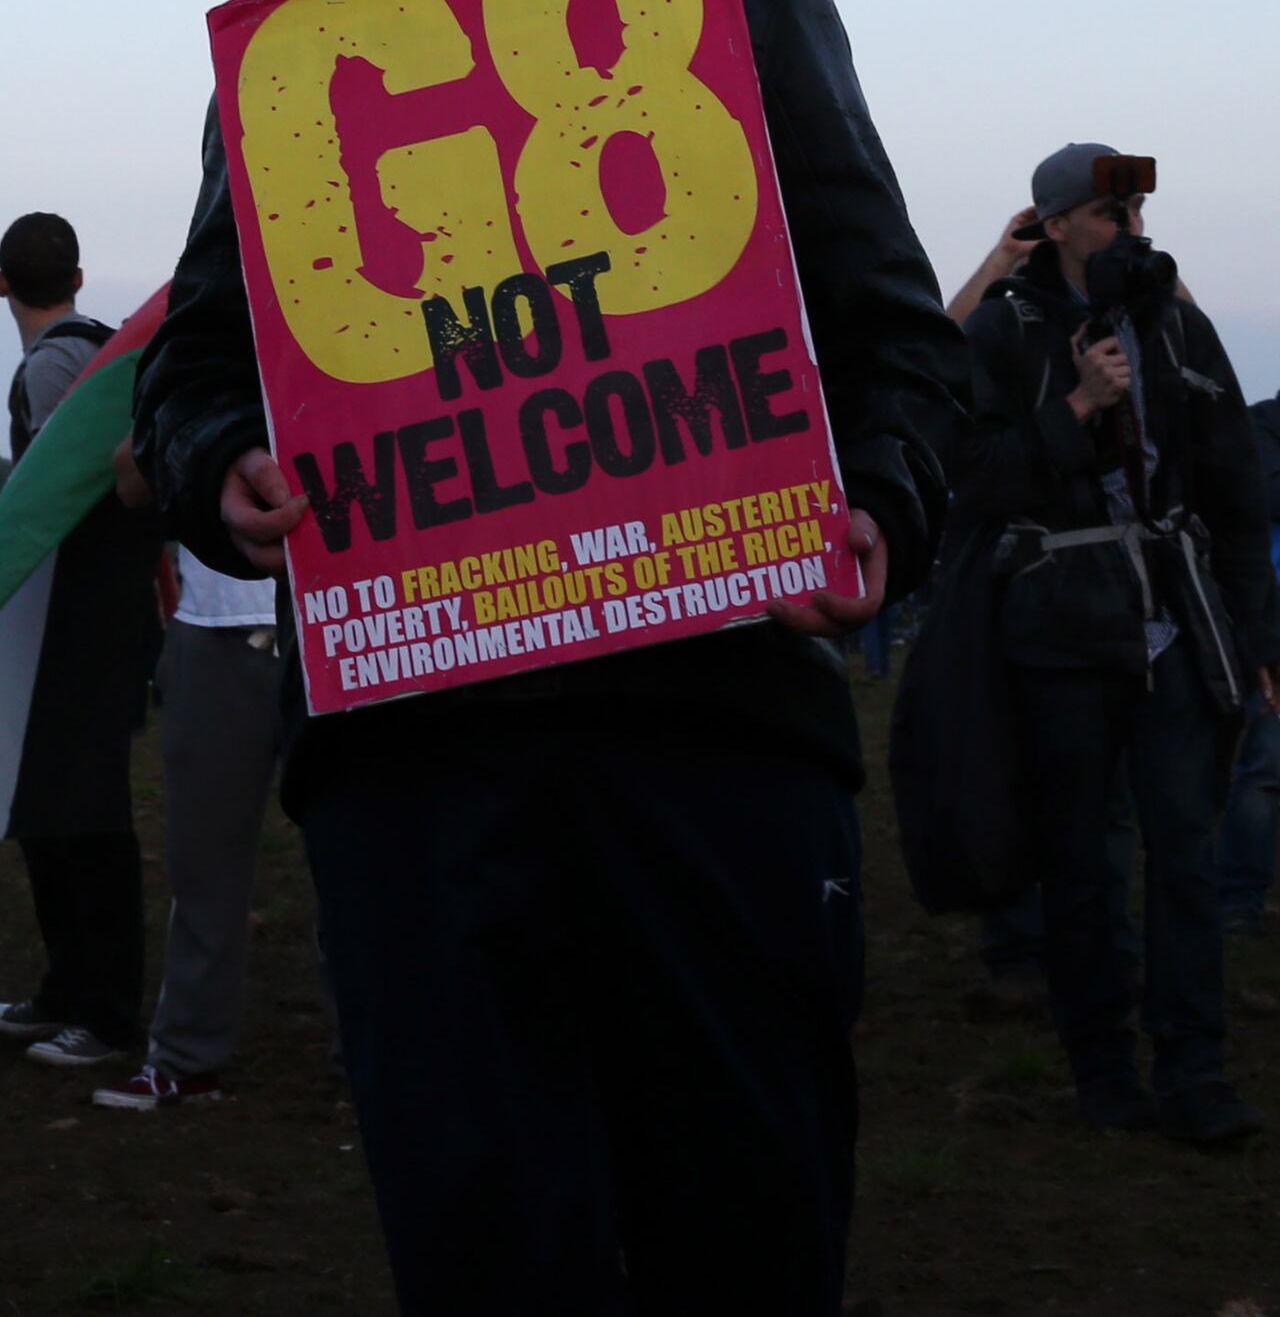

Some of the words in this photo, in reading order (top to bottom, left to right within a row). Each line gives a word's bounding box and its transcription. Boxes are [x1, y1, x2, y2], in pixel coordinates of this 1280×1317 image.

[422, 251, 612, 402] NOT
[293, 328, 810, 554] WELCOME
[303, 585, 349, 625] NO
[358, 575, 398, 612] TO
[401, 540, 569, 604] FRACKING,
[569, 520, 658, 566] WAR,
[660, 480, 840, 547] AUSTERITY,
[323, 596, 470, 658] POVERTY,
[473, 564, 629, 626] BAILOUTS
[633, 554, 673, 591] OF
[675, 538, 739, 581] THE
[743, 519, 834, 571] RICH,
[338, 616, 601, 691] ENVIRONMENTAL
[603, 555, 827, 634] DESTRUCTION
